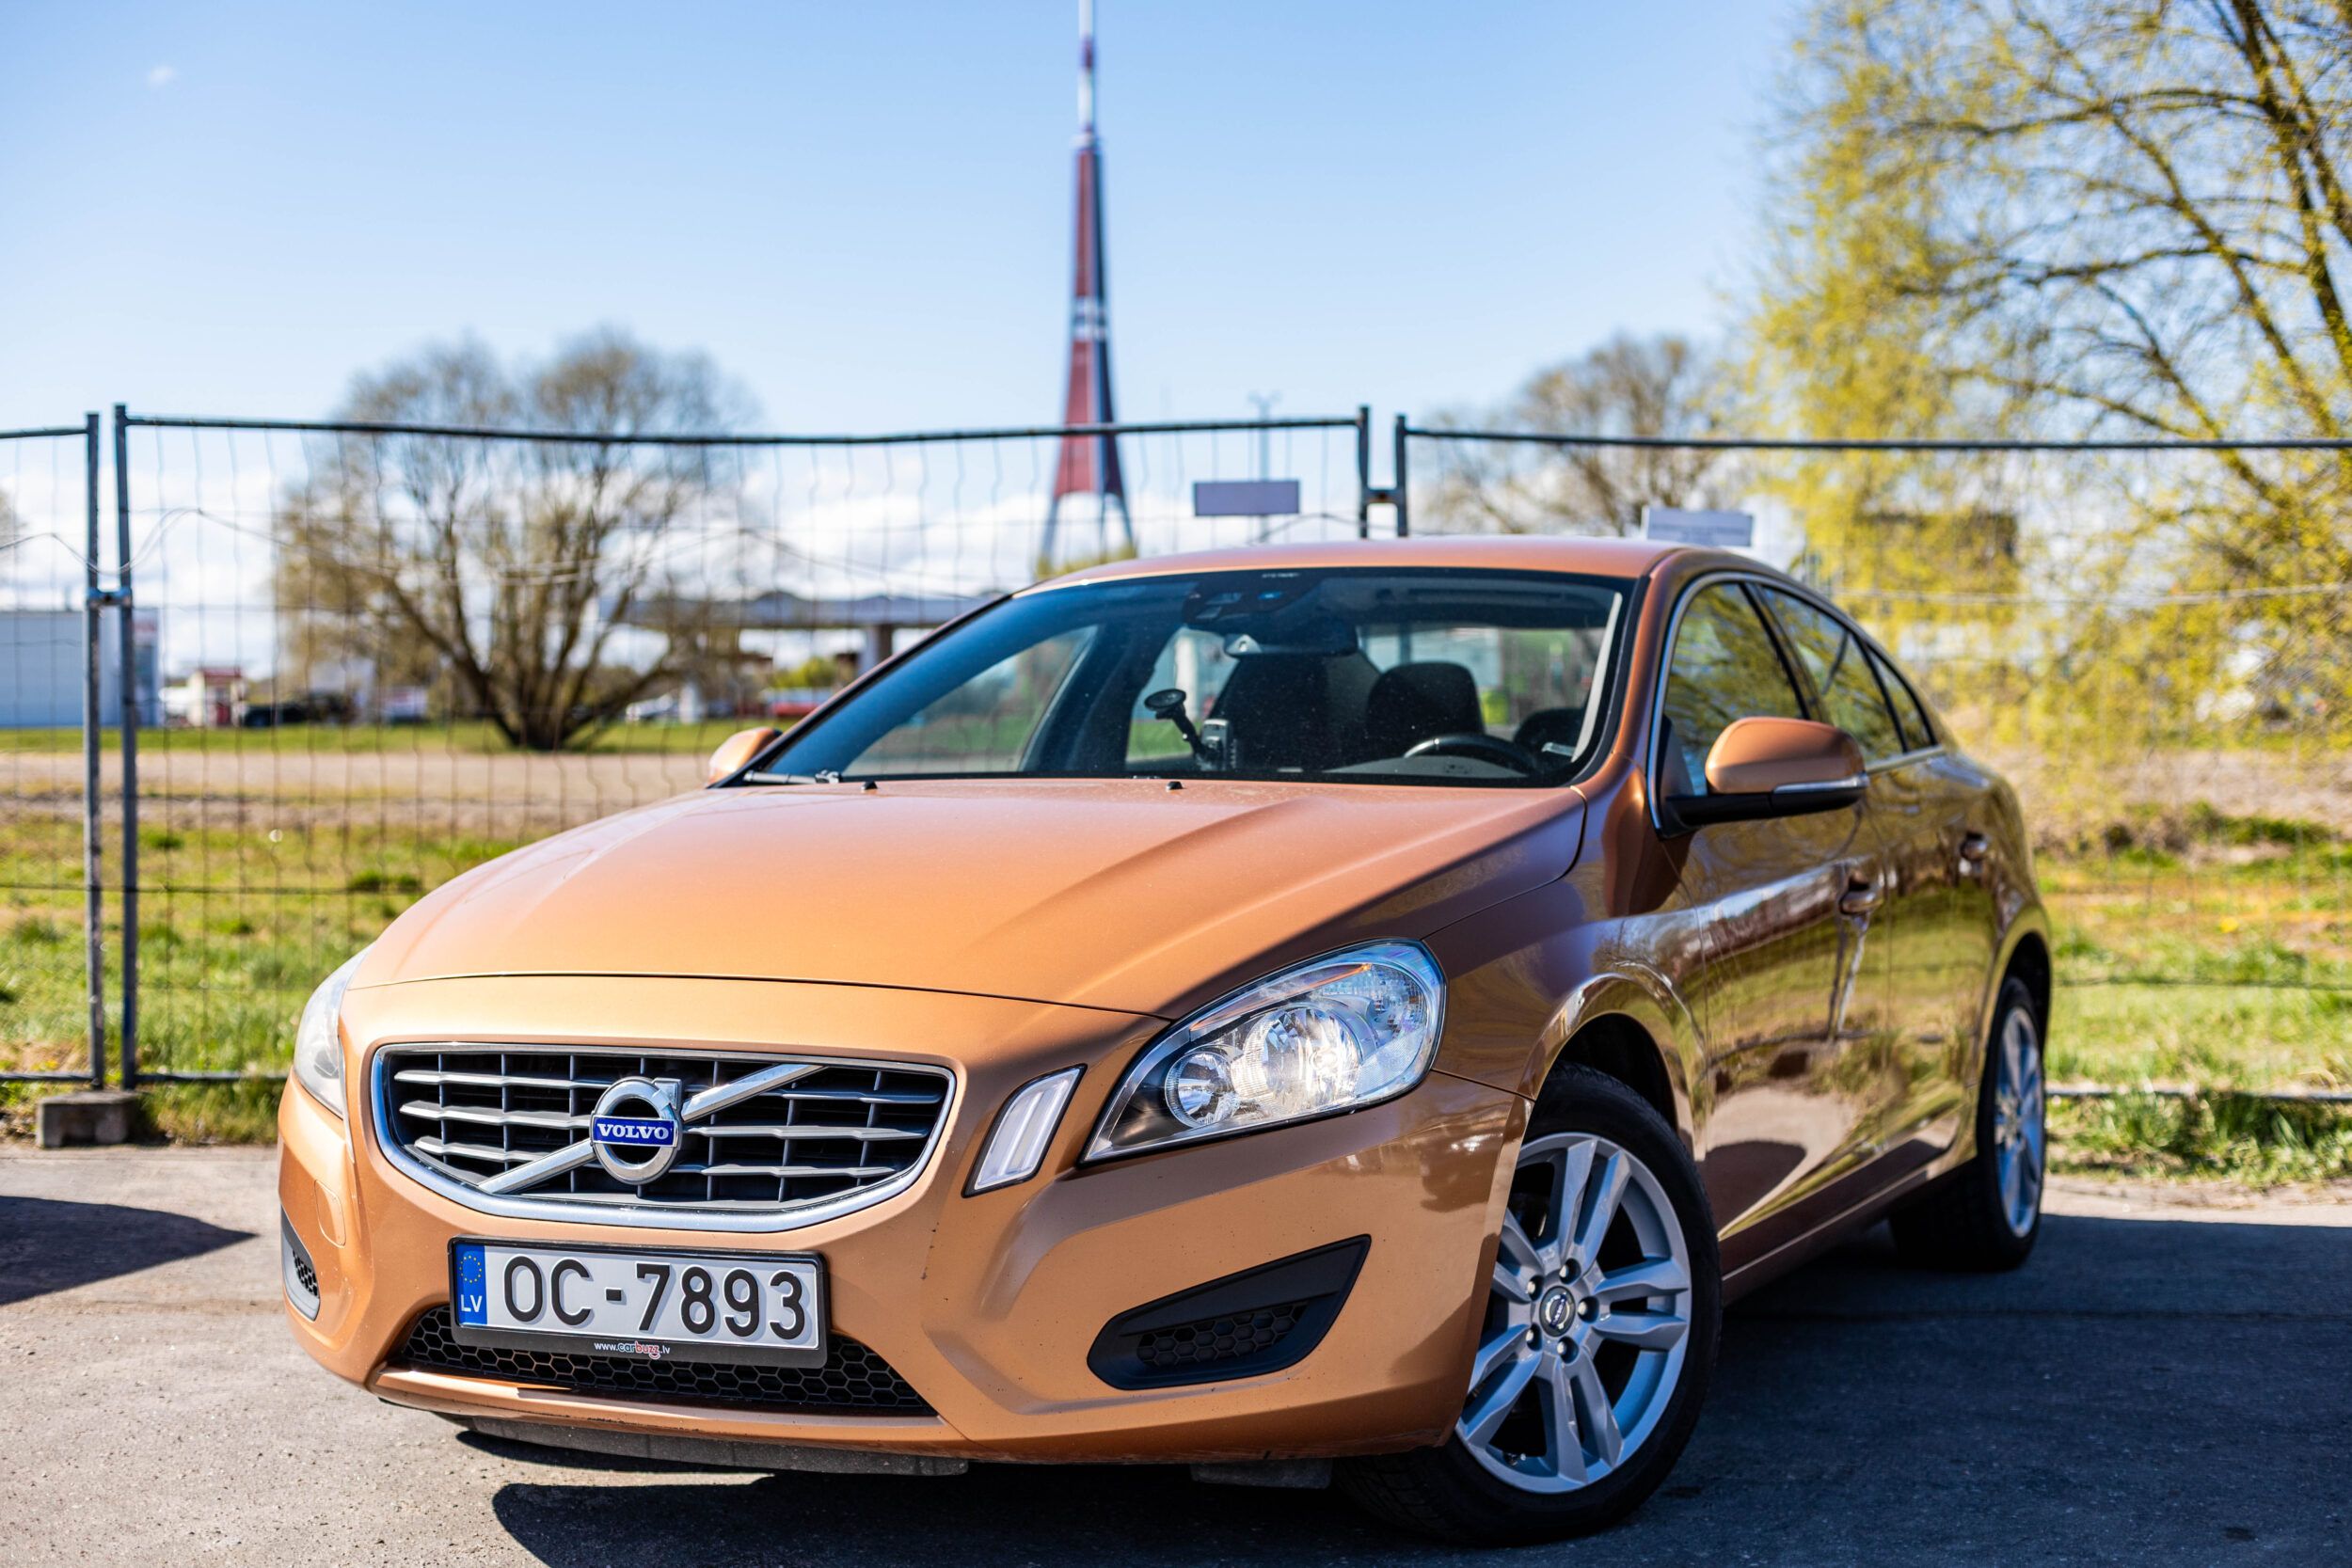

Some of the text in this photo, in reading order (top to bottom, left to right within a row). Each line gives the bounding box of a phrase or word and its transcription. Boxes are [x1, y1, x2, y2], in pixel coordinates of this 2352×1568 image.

[596, 1123, 669, 1140] VOLVO
[460, 1294, 483, 1313] LV
[503, 1256, 805, 1340] OC-7893
[594, 1340, 671, 1354] www.carbuzz.lv
